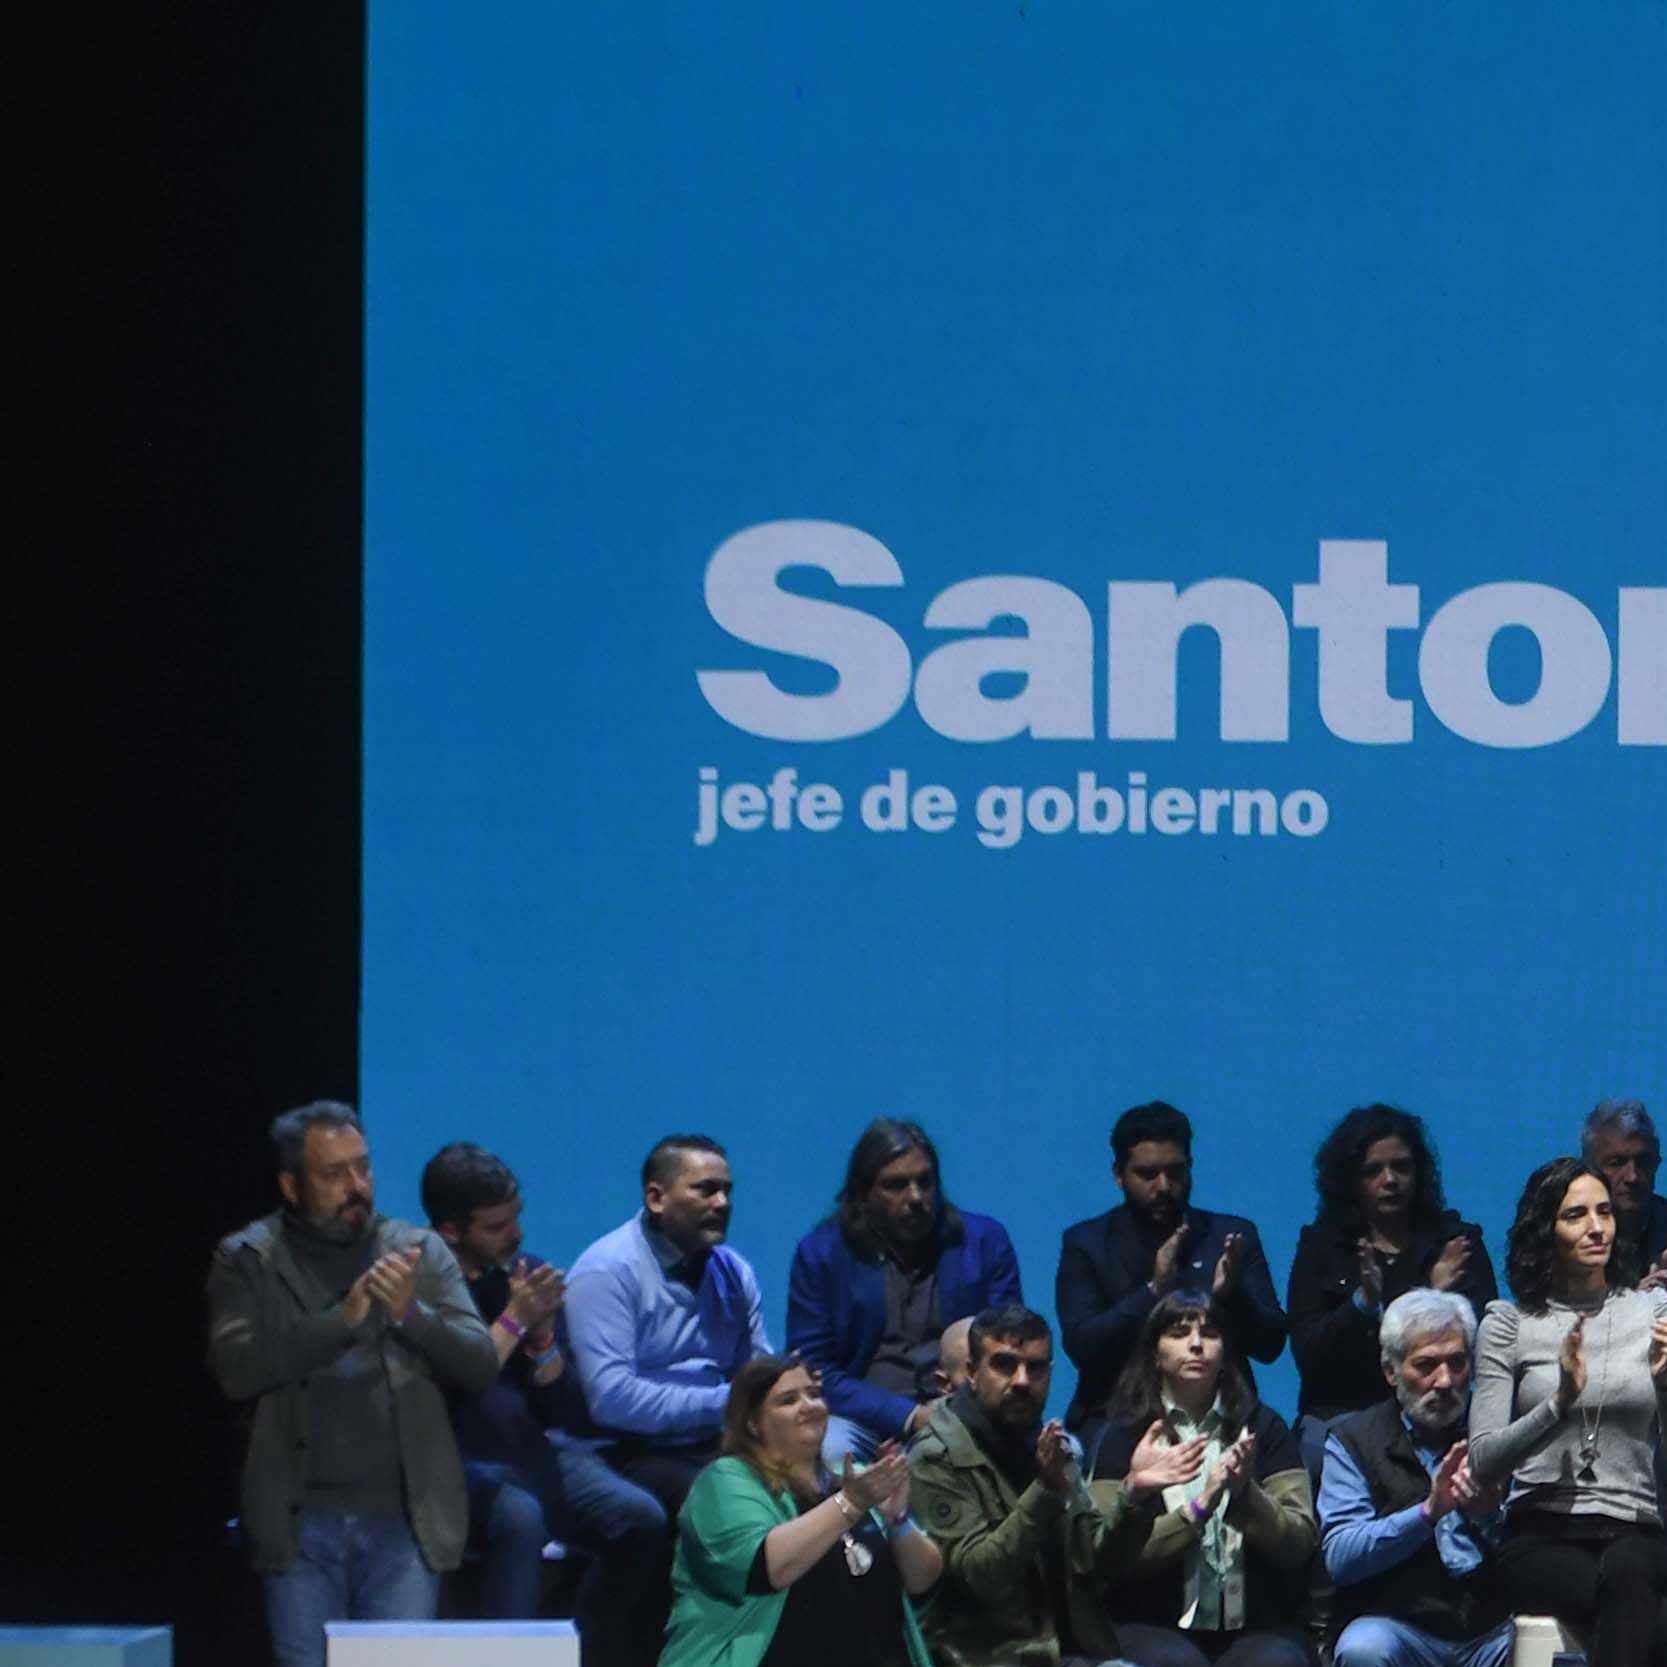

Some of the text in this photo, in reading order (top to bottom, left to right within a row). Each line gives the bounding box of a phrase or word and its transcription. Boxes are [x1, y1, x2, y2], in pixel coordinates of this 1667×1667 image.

[695, 768, 1328, 848] jefe de gobierno
